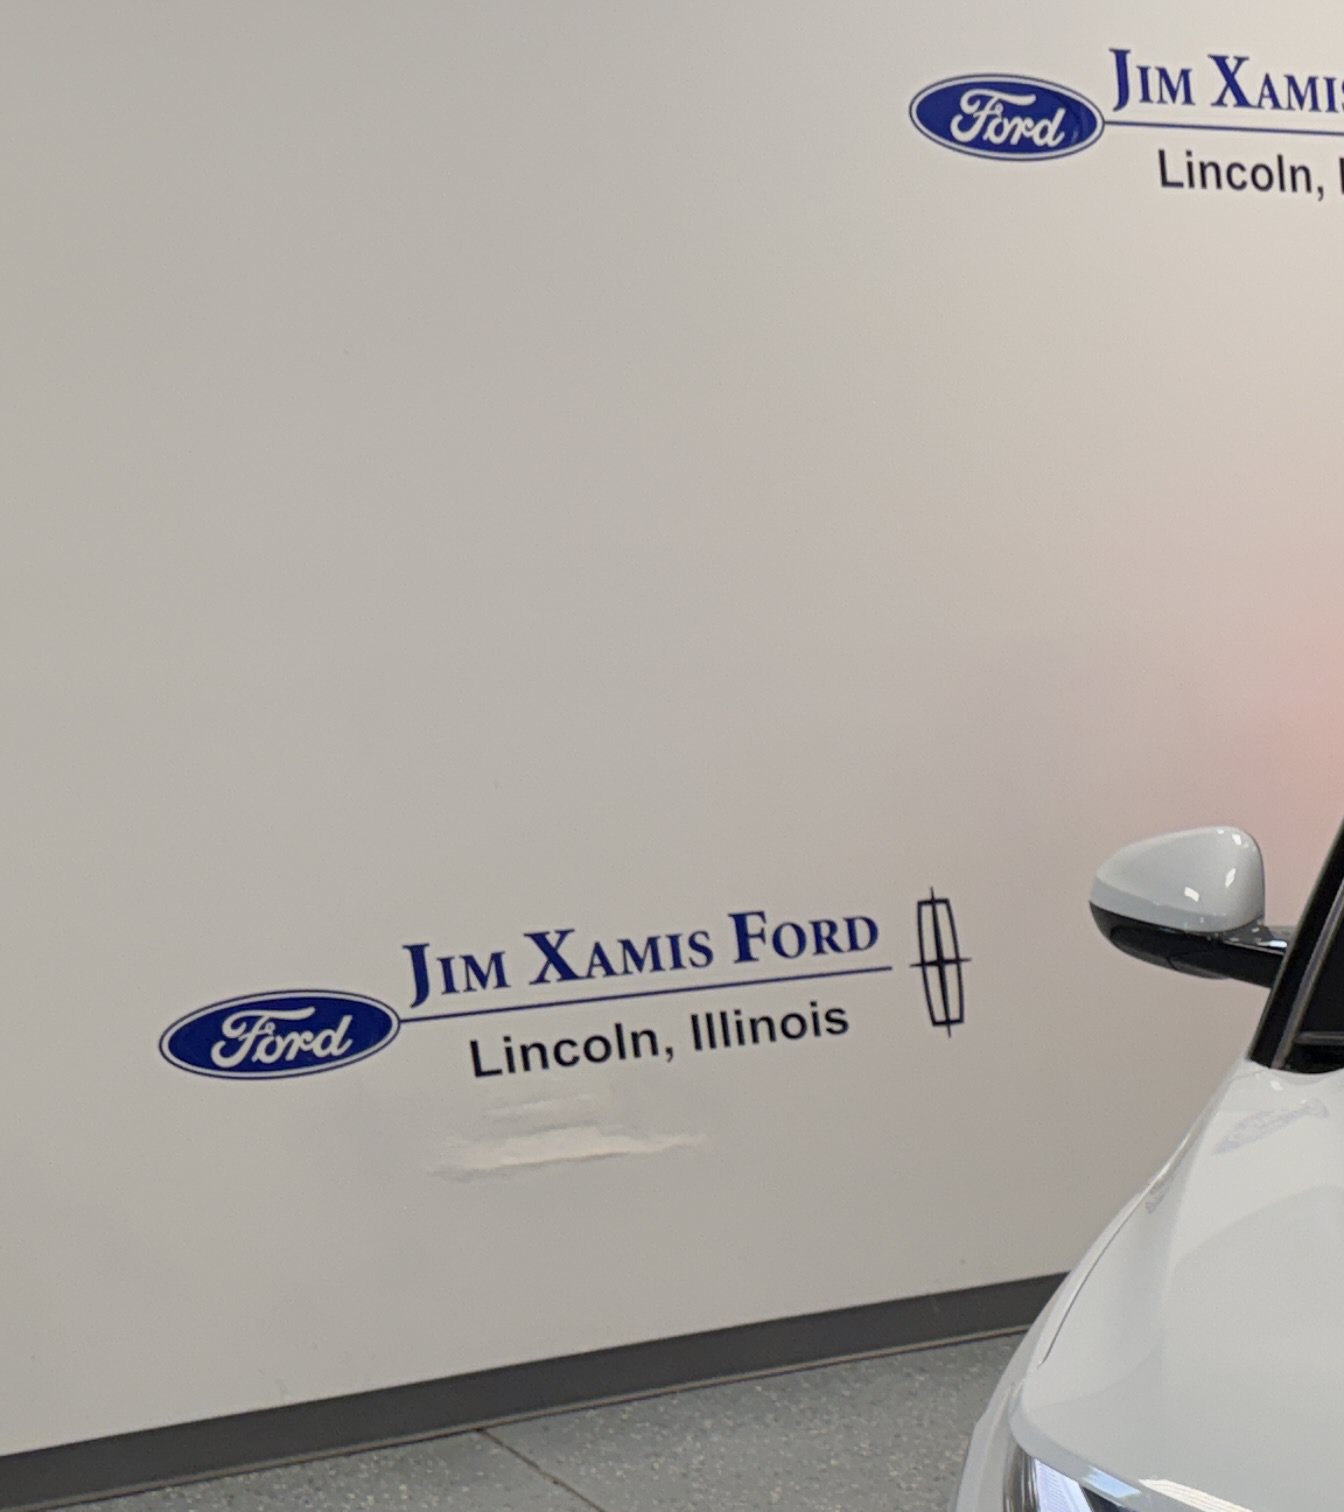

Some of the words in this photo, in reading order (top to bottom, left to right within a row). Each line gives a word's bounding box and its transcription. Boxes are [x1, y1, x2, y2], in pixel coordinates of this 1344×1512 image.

[1109, 48, 1194, 111] JIM
[950, 88, 1066, 148] Ford
[1158, 149, 1325, 201] Lincoln,
[403, 942, 506, 1008] JIM
[523, 928, 713, 984] XAMIS
[728, 910, 880, 965] FORD
[209, 1006, 354, 1068] Ford
[470, 1022, 675, 1078] Lincoln,
[691, 1001, 850, 1053] Illinois
